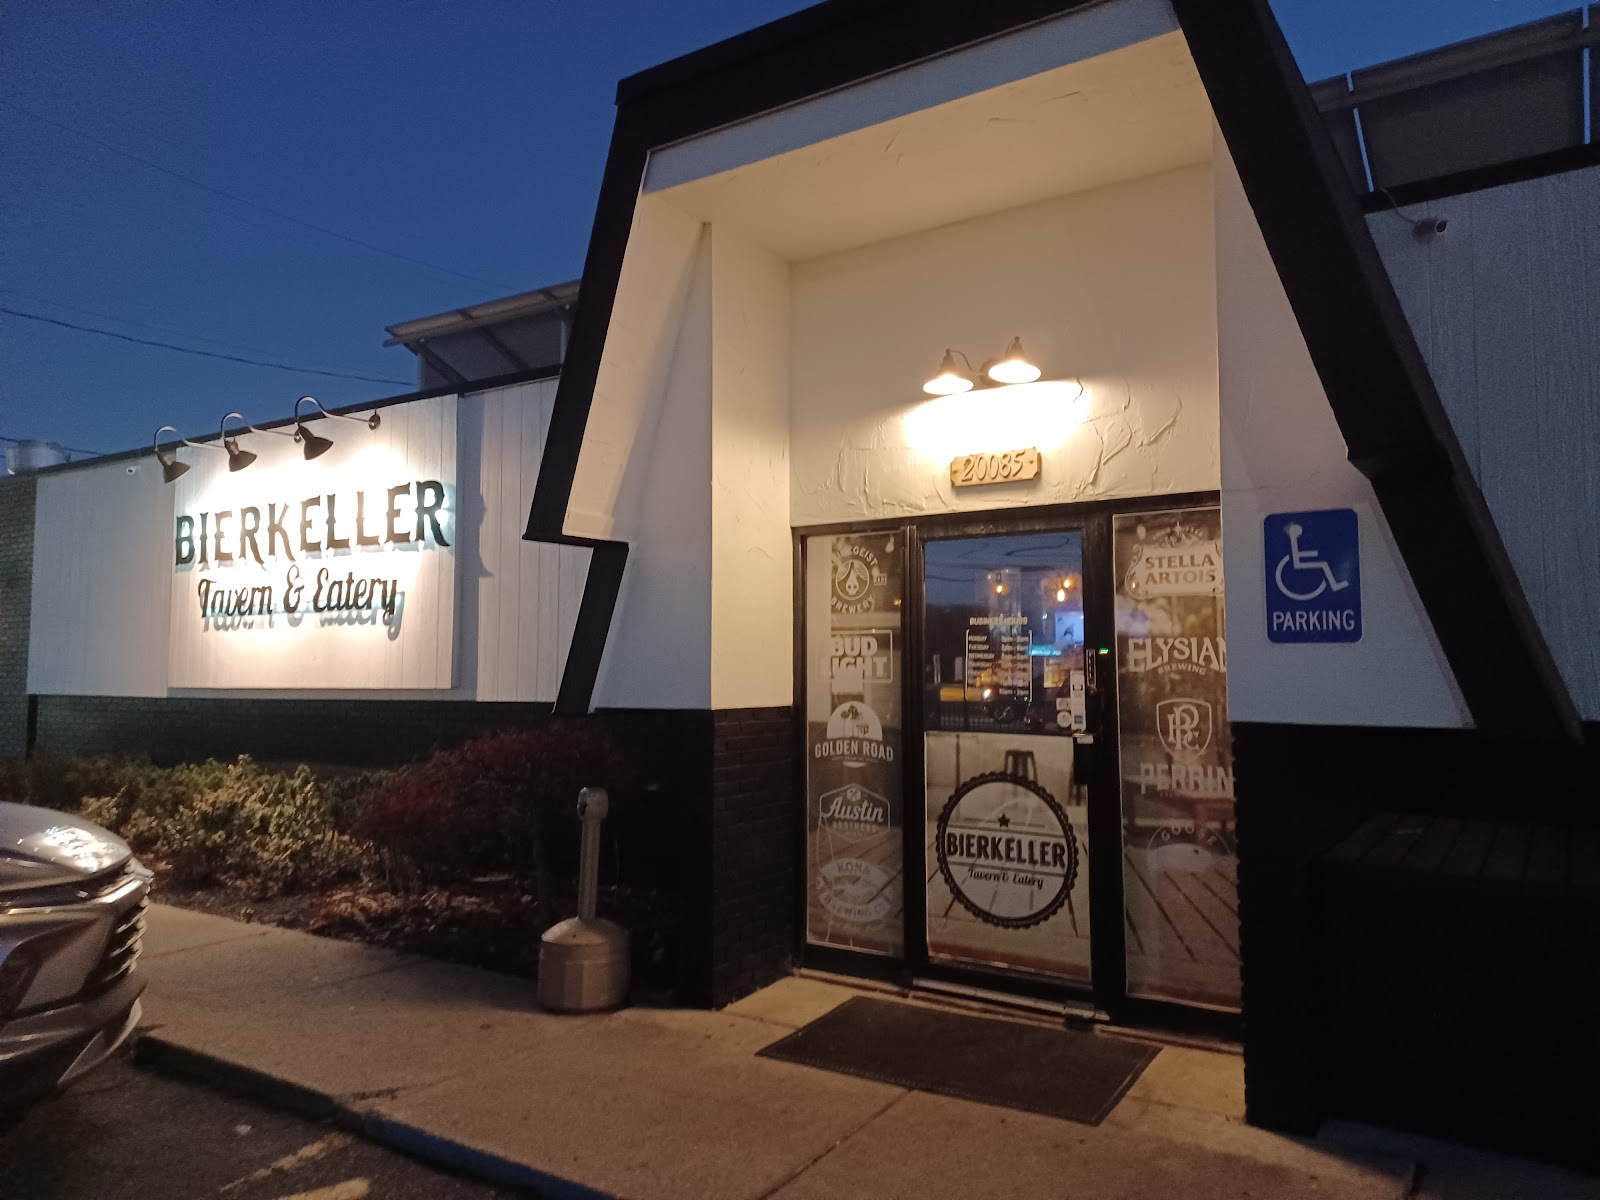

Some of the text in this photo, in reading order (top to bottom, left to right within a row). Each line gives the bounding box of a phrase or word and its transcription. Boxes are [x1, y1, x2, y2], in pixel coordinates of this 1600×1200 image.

[961, 451, 1025, 482] 20085
[174, 480, 451, 566] BIERKELLER
[1145, 553, 1215, 570] STELLA
[1145, 568, 1218, 586] ARTOIS
[198, 565, 397, 620] Tavern & Eatery
[1273, 609, 1355, 631] PARKING
[831, 635, 878, 657] BUD
[831, 657, 888, 678] IGHT
[1158, 662, 1207, 675] BREWING
[814, 739, 894, 762] GOLDEN ROAD
[821, 796, 884, 823] Austin
[946, 832, 1066, 869] BIERKELLER
[968, 868, 1000, 882] Tavern
[1012, 873, 1044, 890] Eatery
